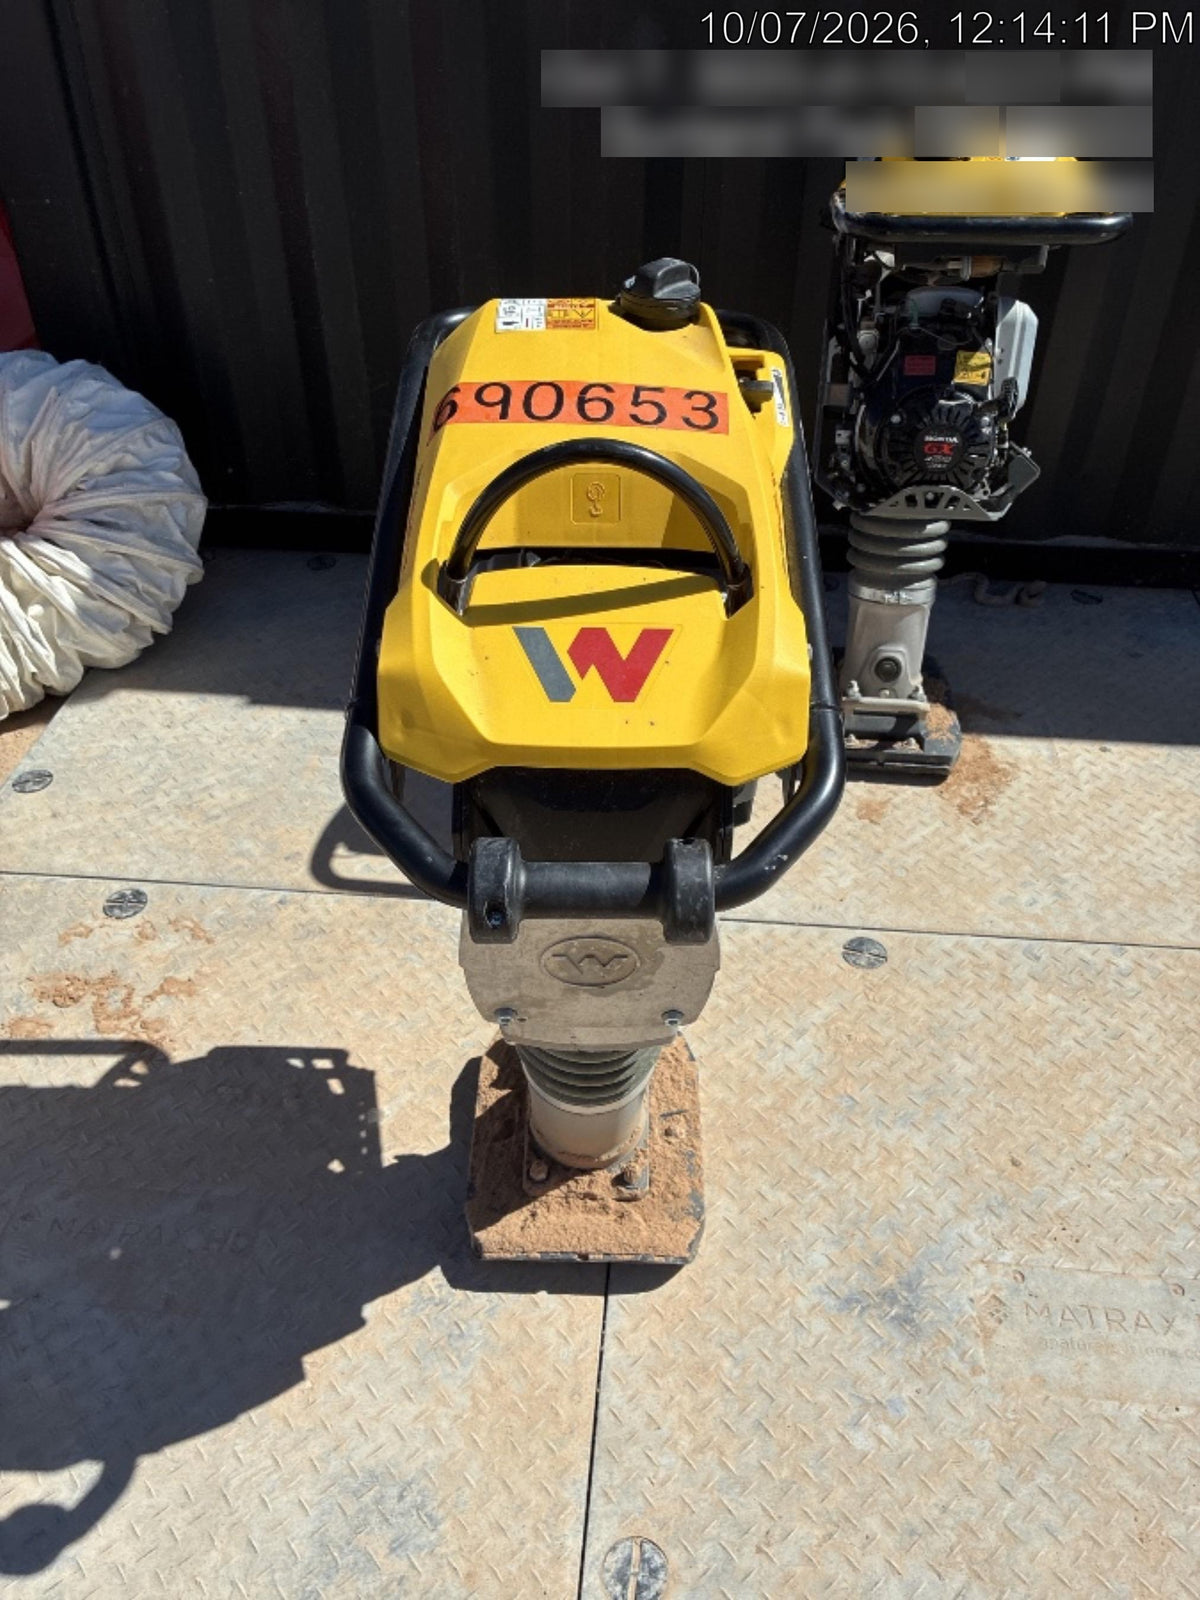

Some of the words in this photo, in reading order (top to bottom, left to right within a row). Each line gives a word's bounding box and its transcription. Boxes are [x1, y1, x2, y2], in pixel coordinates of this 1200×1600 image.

[429, 381, 719, 432] 690653
[923, 443, 953, 455] GX
[1024, 1301, 1181, 1337] MATRAX
